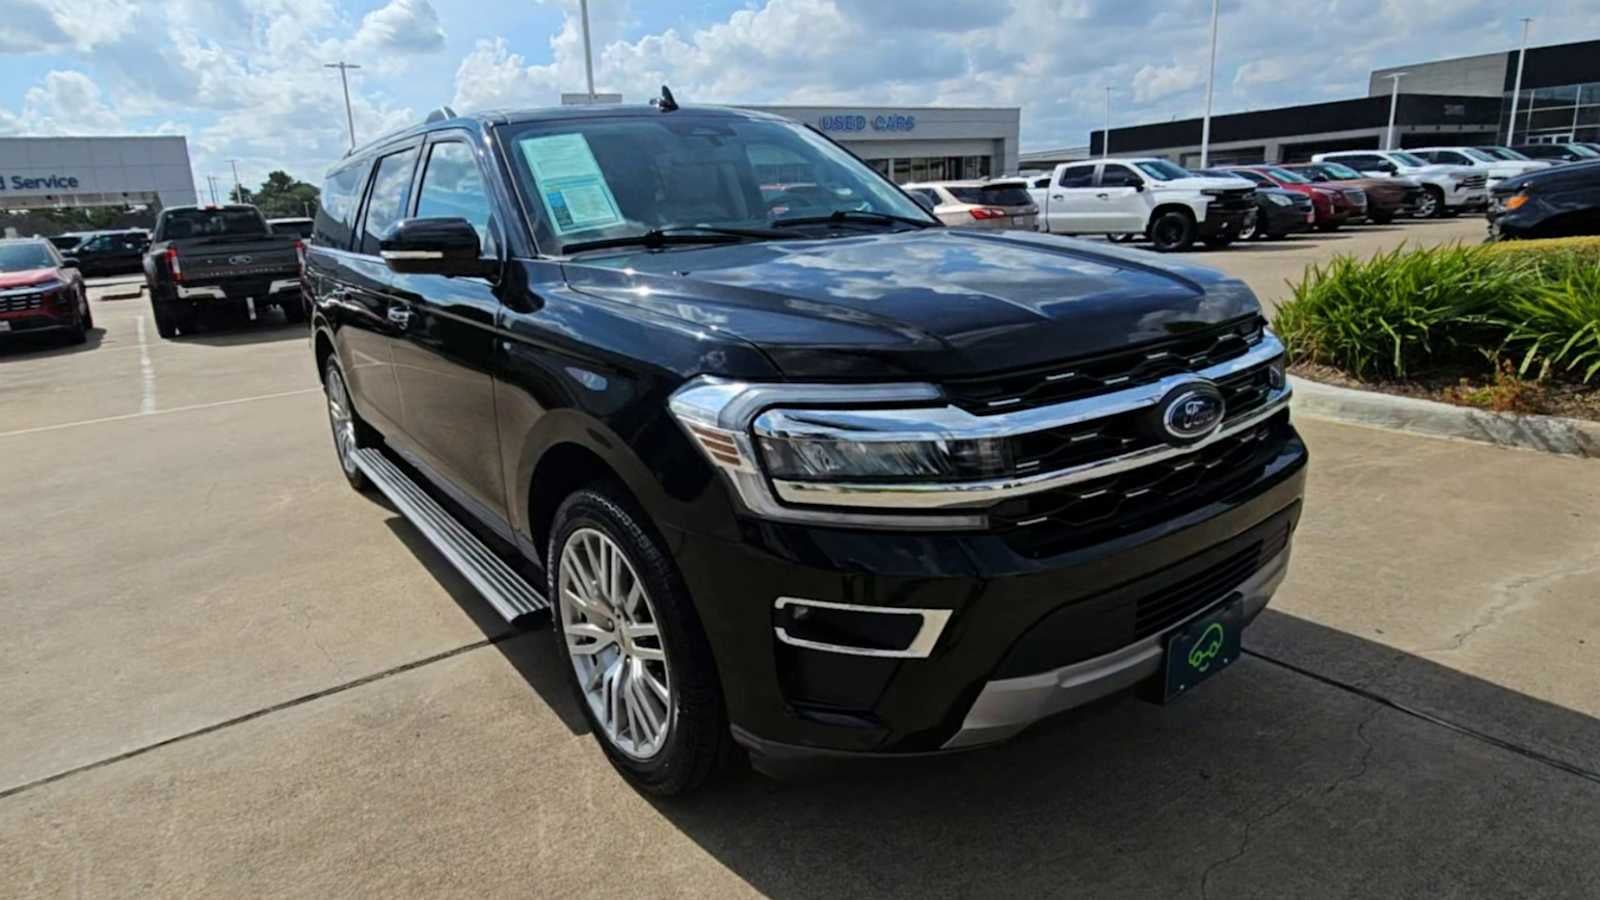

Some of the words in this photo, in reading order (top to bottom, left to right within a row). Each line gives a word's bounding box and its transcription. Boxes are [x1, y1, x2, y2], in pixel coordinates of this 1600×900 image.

[819, 114, 866, 131] USED
[870, 113, 915, 131] CARS
[11, 174, 79, 190] Service
